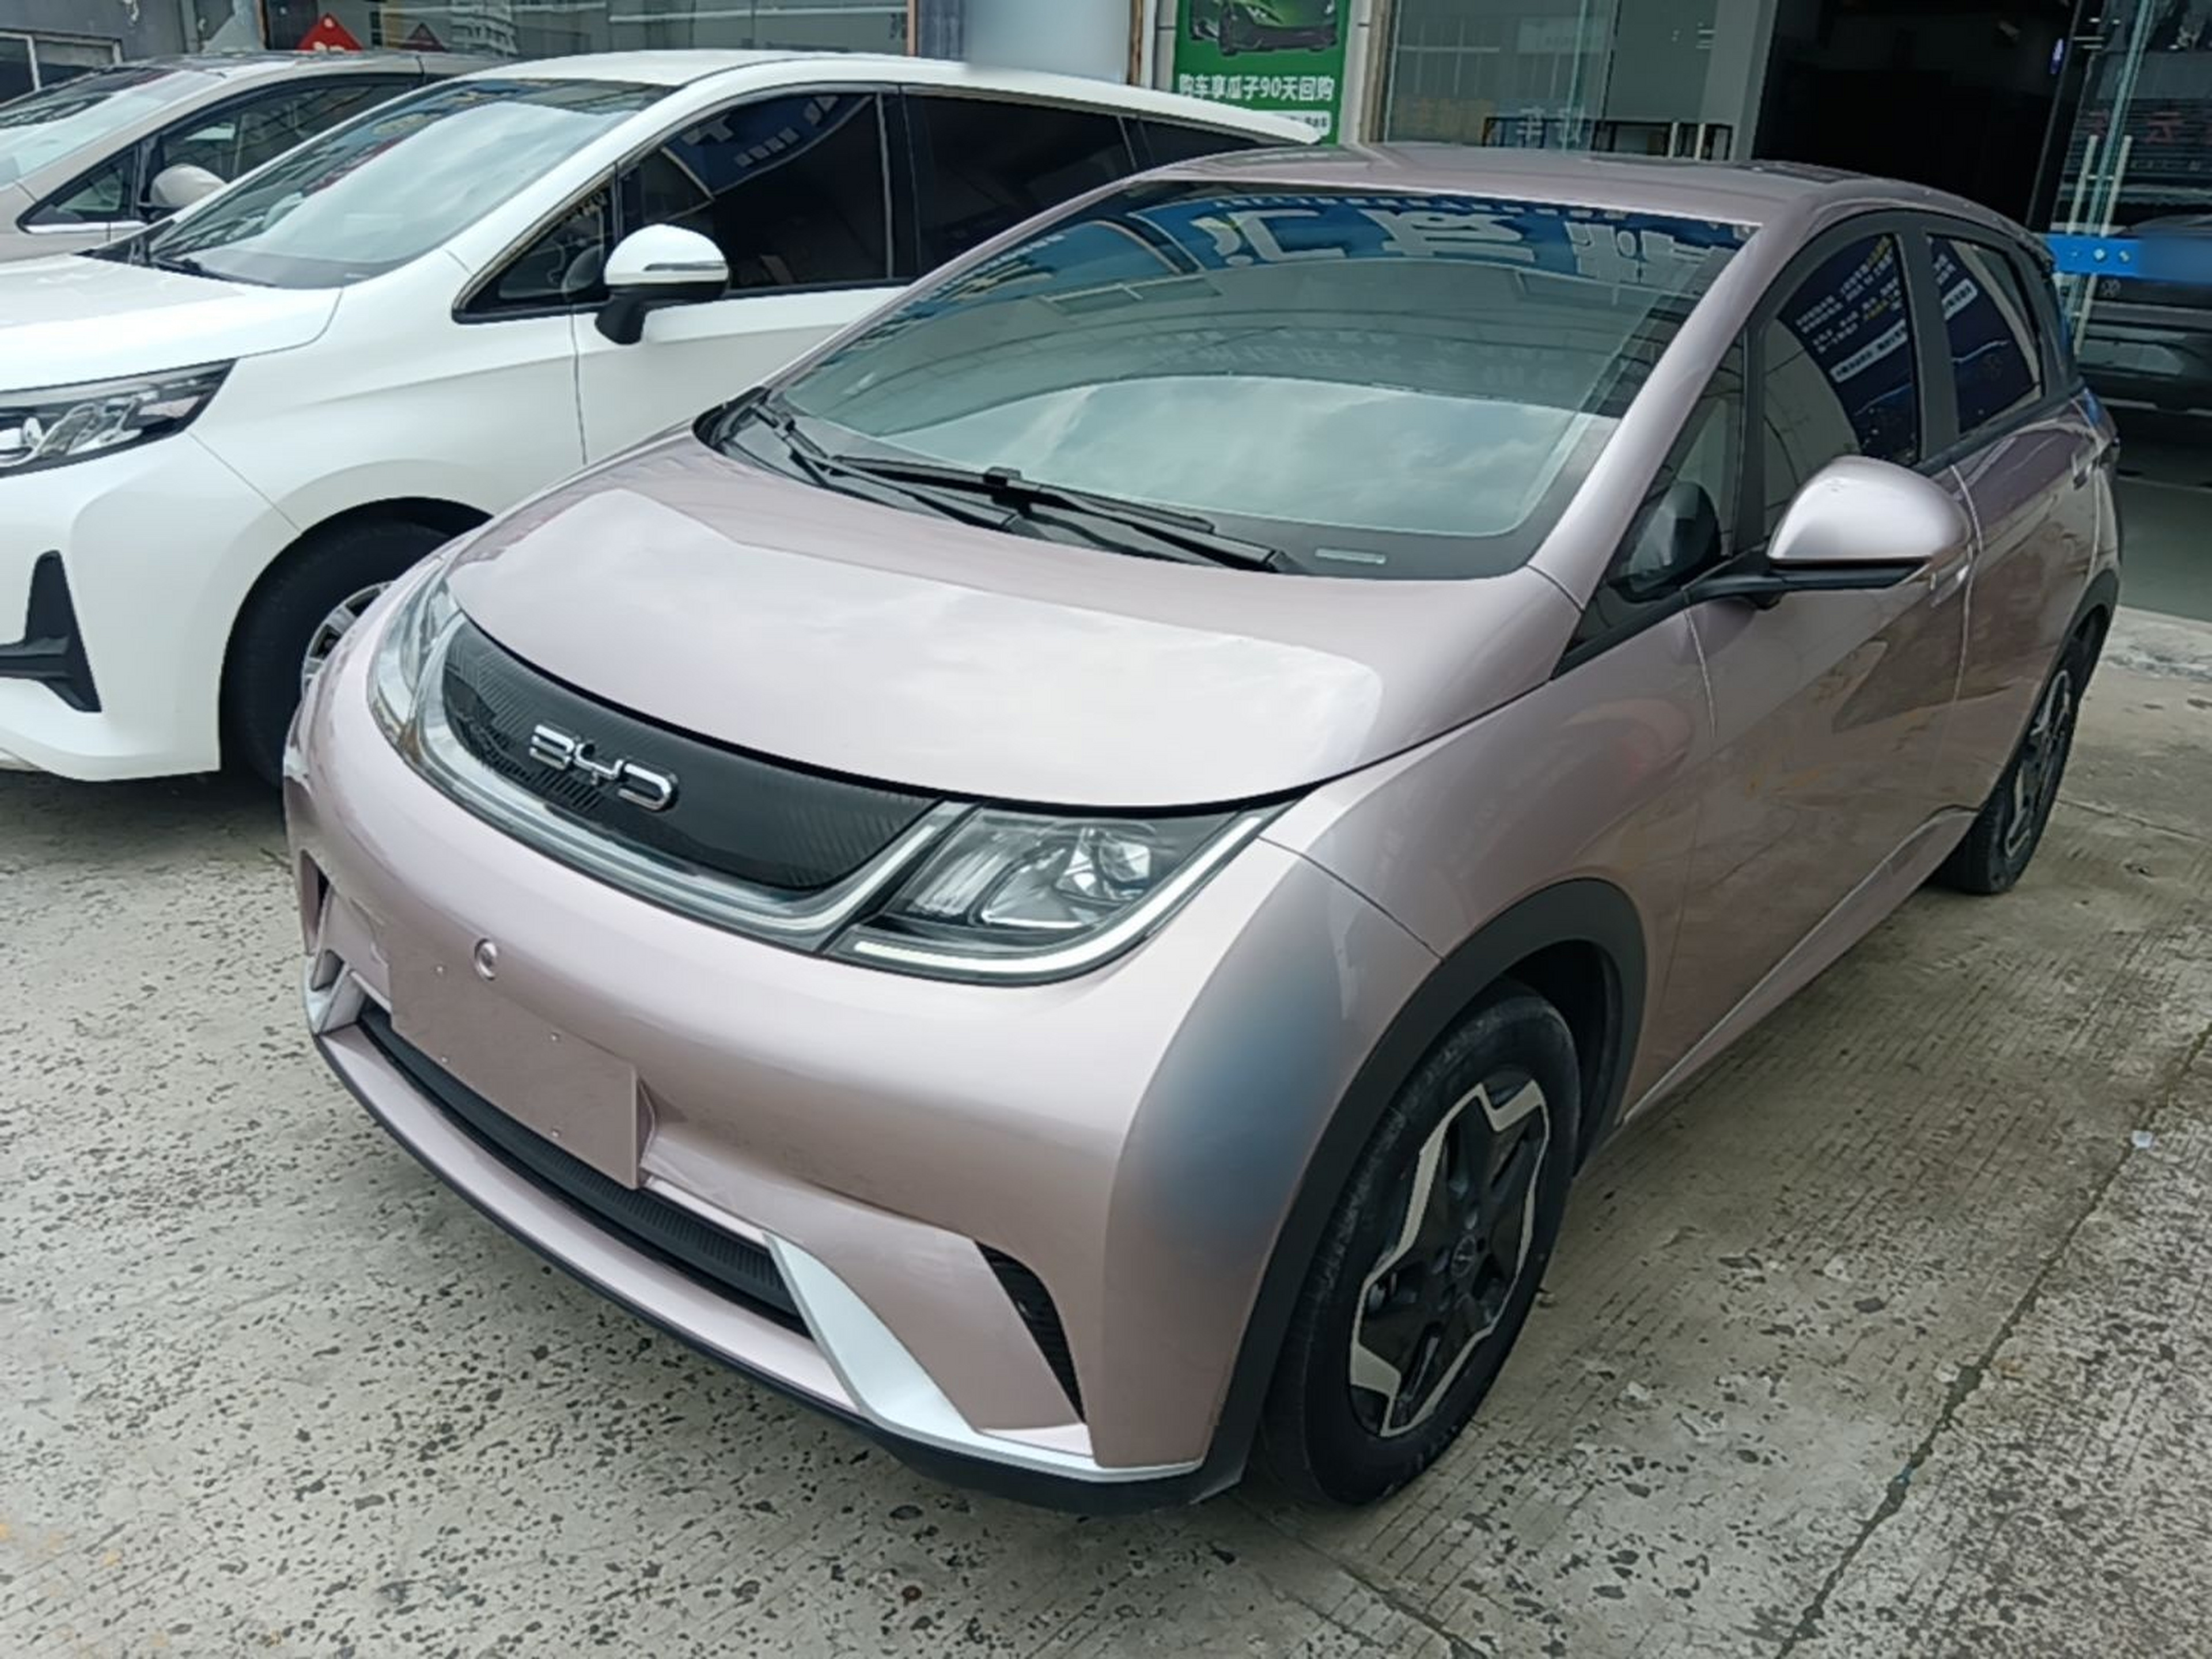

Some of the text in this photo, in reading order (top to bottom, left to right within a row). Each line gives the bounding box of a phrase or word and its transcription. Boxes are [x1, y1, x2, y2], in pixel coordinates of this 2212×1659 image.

[1179, 74, 1335, 101] 购车享瓜子90天回购
[529, 724, 672, 810] BYD
